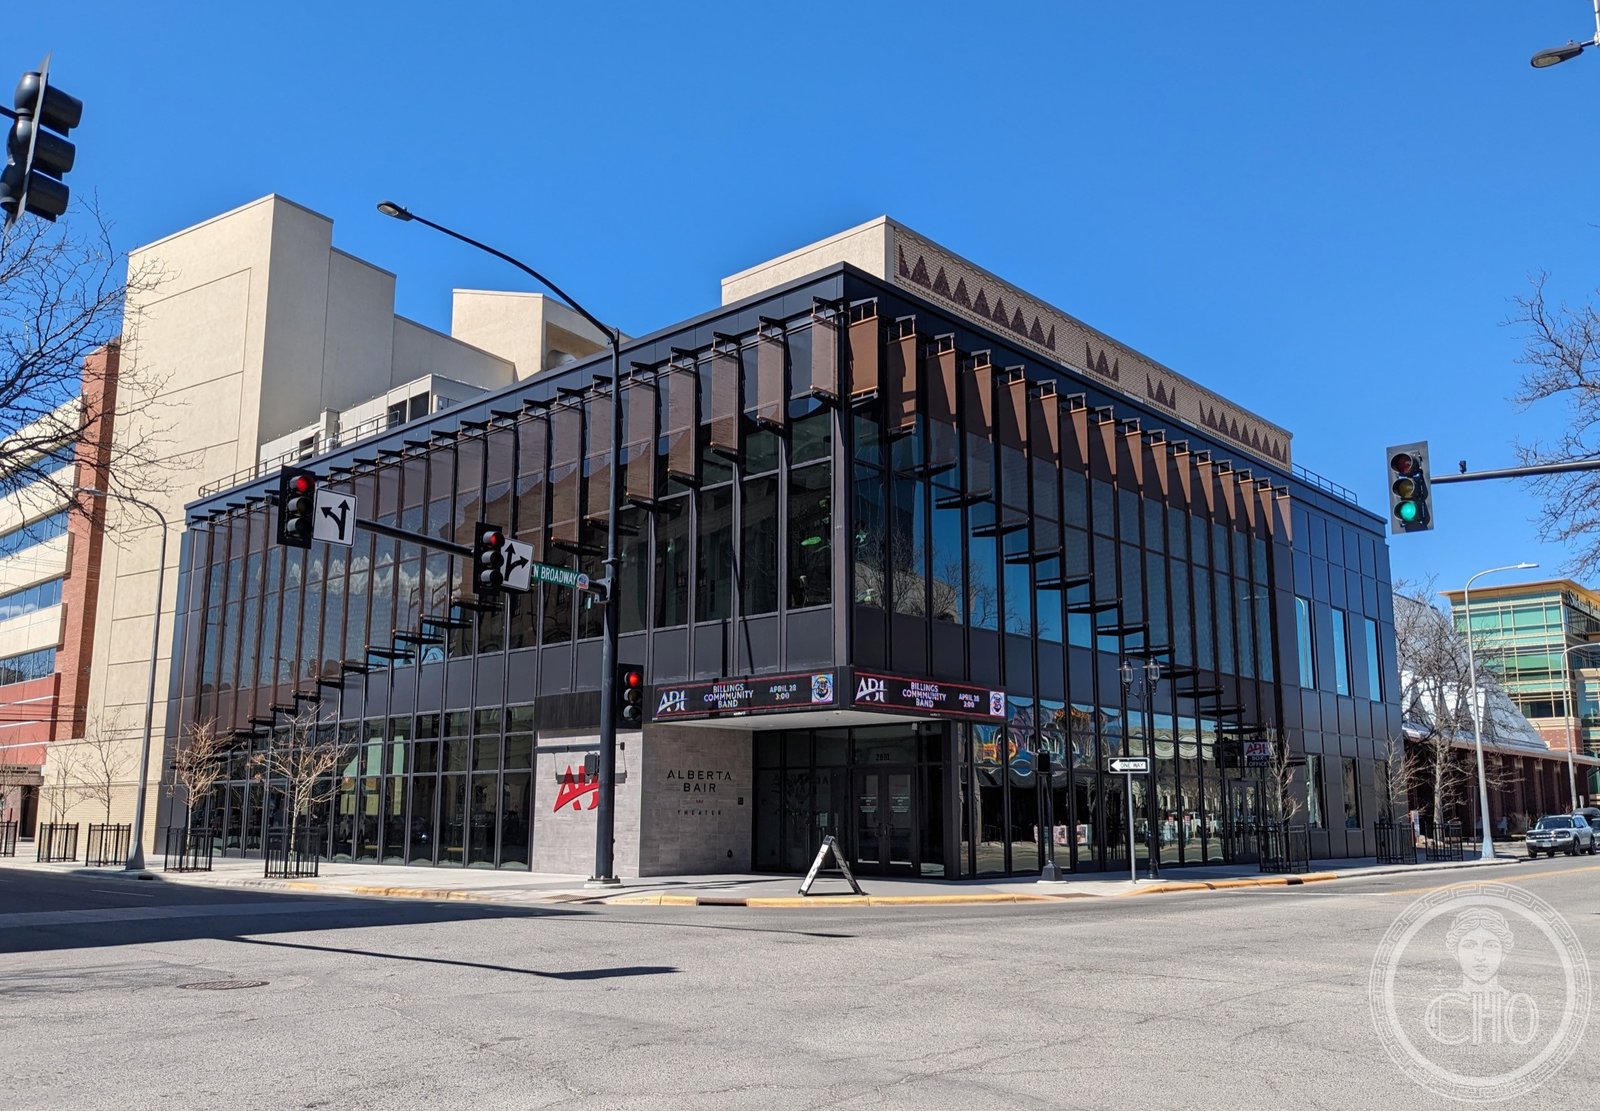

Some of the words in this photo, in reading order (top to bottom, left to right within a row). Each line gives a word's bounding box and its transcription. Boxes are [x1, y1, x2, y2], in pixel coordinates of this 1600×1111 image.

[533, 565, 539, 578] N
[541, 566, 578, 586] BROADWAY
[712, 683, 744, 694] BILLINGS
[769, 685, 787, 693] APRIL
[910, 681, 939, 693] BILLINGS
[718, 699, 739, 709] BAND
[915, 697, 934, 709] BAND
[666, 769, 732, 781] ALBERTA
[683, 782, 716, 793] BAIR
